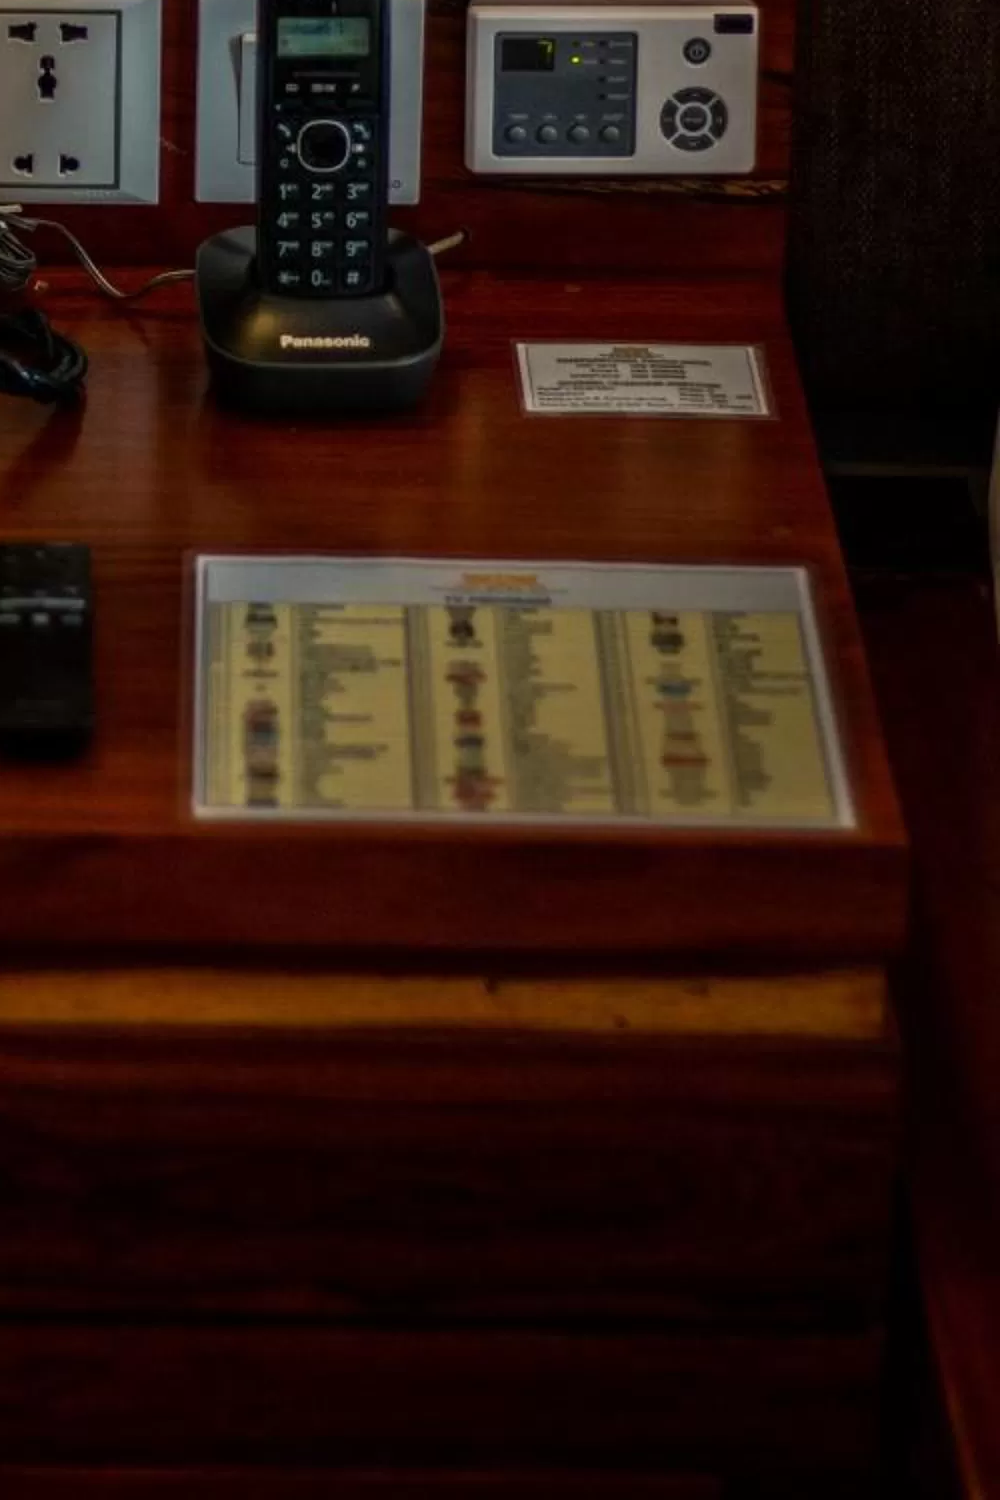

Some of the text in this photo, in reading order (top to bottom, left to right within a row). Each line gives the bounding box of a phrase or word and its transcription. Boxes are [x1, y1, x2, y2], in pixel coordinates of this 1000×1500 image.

[311, 183, 321, 200] 2
[346, 183, 357, 200] 3
[276, 212, 288, 228] 4
[311, 212, 322, 228] 5
[346, 212, 356, 228] 6
[311, 240, 322, 257] 8
[346, 240, 357, 257] 9
[311, 269, 321, 286] 0
[280, 334, 370, 348] Panasonic
